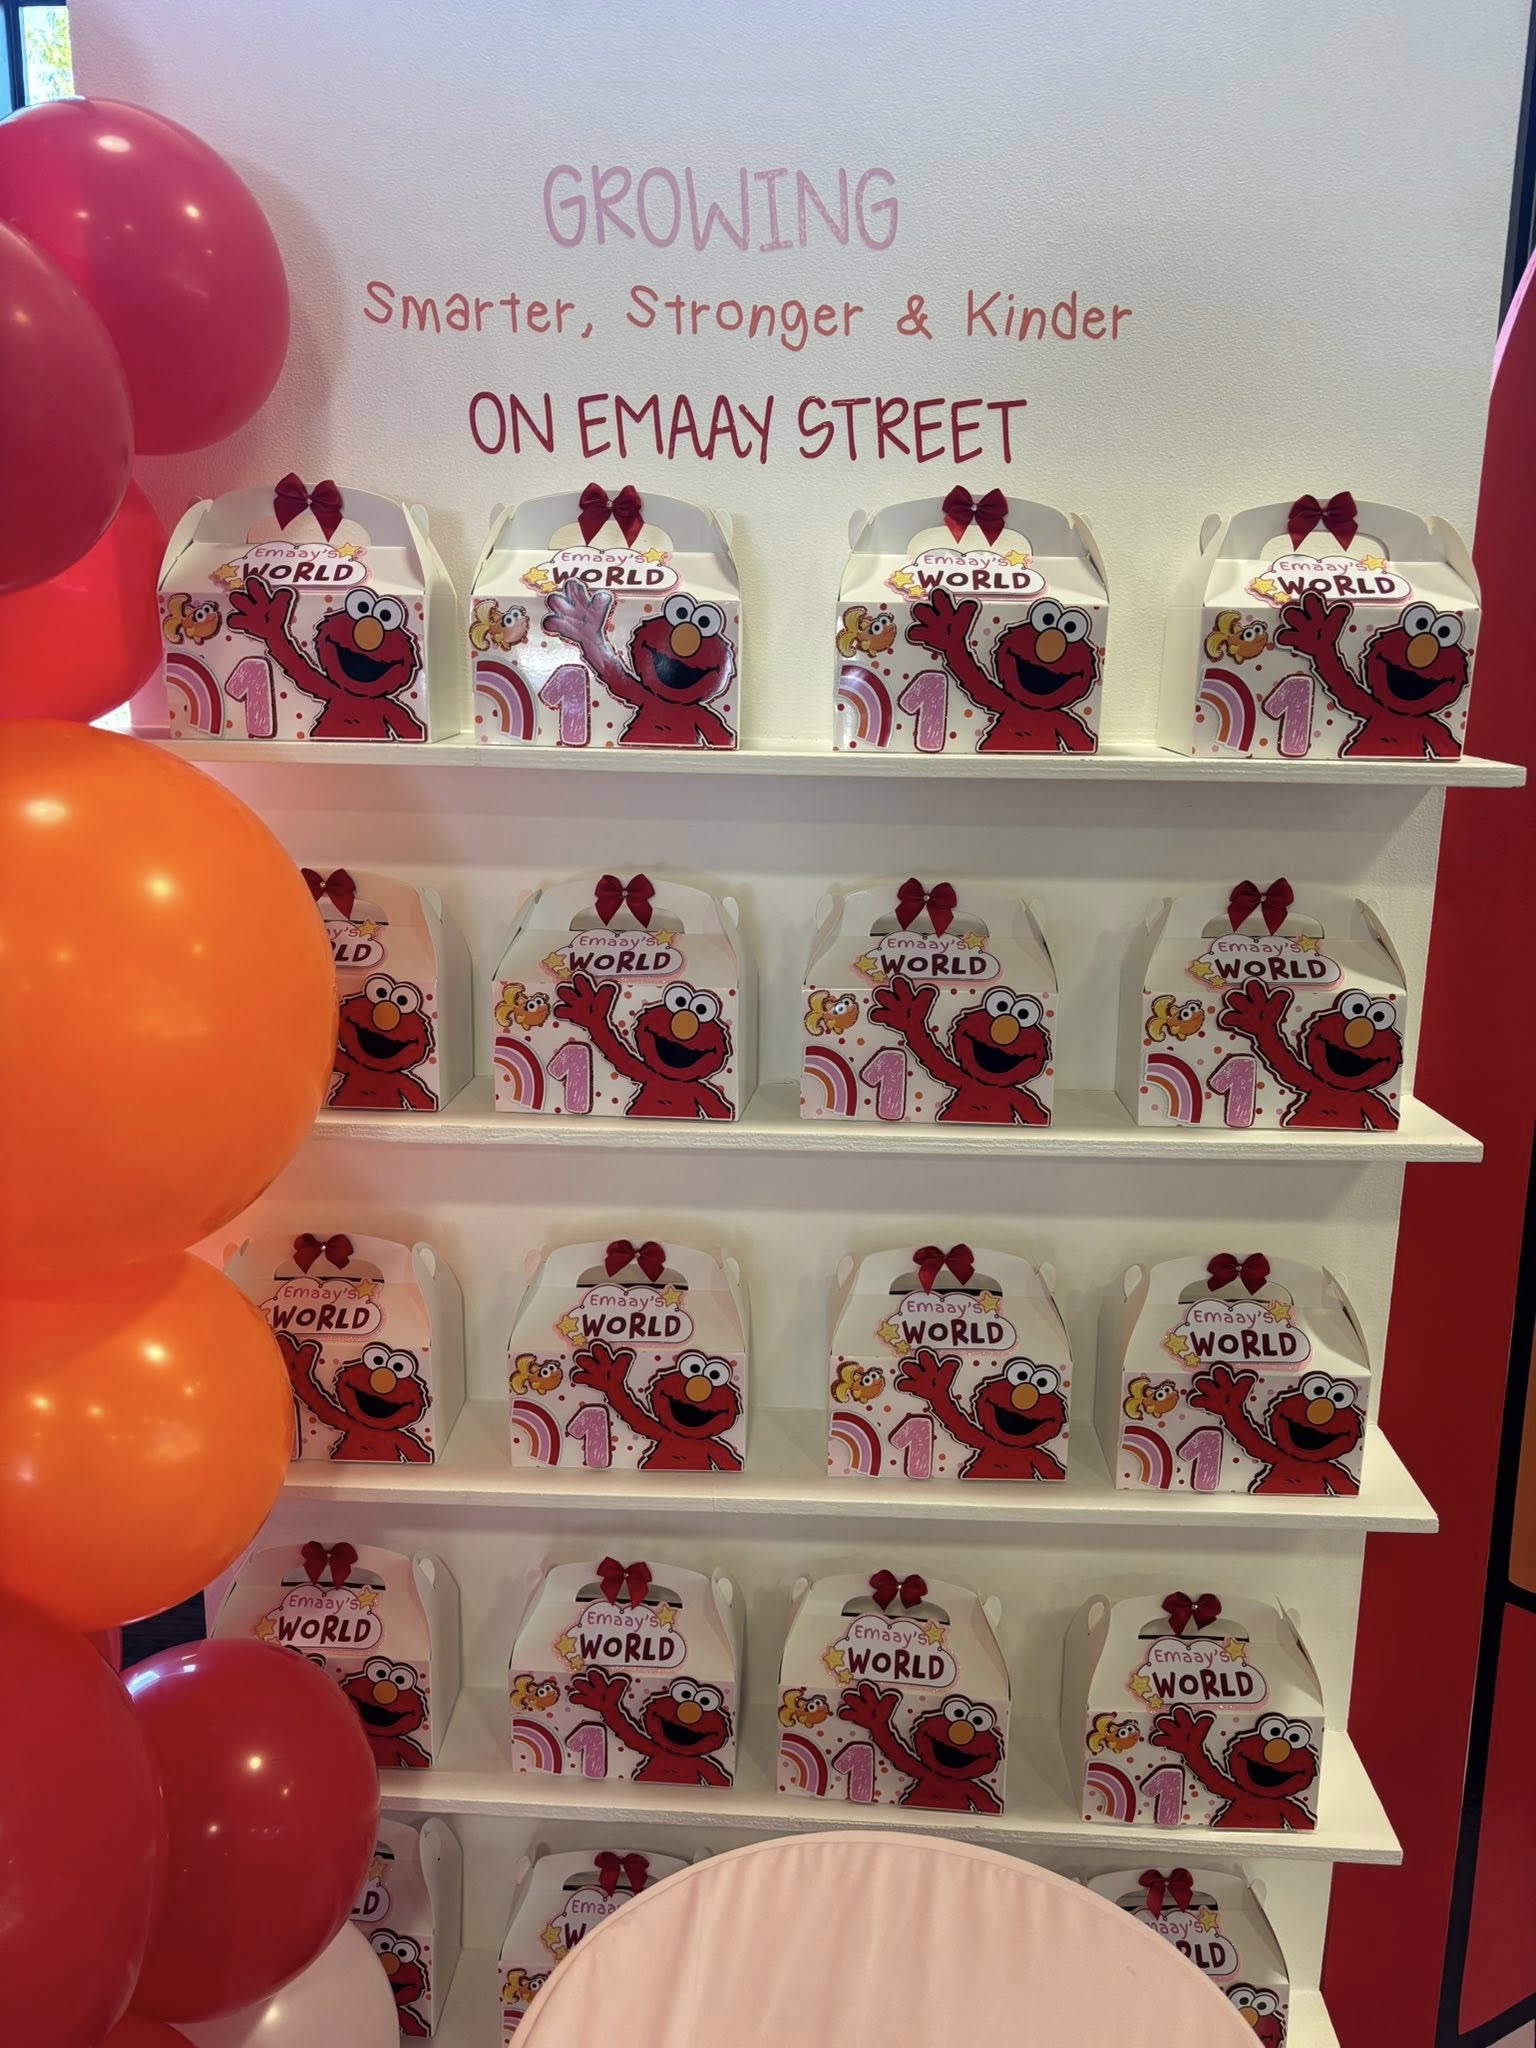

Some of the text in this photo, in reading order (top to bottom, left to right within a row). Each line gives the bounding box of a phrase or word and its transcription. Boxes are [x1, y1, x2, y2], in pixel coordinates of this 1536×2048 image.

[543, 164, 900, 252] GROWING
[363, 281, 1134, 351] Smarter, Stronger & Kinder
[469, 391, 1028, 465] ON EMAAY STREET
[254, 548, 338, 562] Emaay's
[561, 552, 646, 566] Emaay's
[924, 555, 1009, 569] Emaay's
[243, 562, 354, 583] WORLD
[552, 566, 665, 587] WORLD
[1279, 561, 1367, 575] Emaay's
[917, 569, 1031, 590] WORLD
[1277, 575, 1396, 596] WORLD
[579, 935, 657, 951] Emaay's
[887, 938, 967, 953] Emaay's
[1217, 942, 1302, 957] Emaay's
[570, 950, 671, 973] WORLD
[880, 953, 987, 976] WORLD
[1214, 957, 1327, 980] WORLD
[284, 1287, 358, 1304] Emaay's
[590, 1294, 664, 1311] Emaay's
[272, 1304, 370, 1331] WORLD
[907, 1300, 983, 1318] Emaay's
[1193, 1310, 1274, 1328] Emaay's
[582, 1312, 681, 1339] WORLD
[902, 1319, 1004, 1346] WORLD
[1190, 1329, 1297, 1359] WORLD
[289, 1594, 359, 1614] Emaay's
[278, 1615, 371, 1644] WORLD
[587, 1612, 659, 1632] Emaay's
[854, 1625, 928, 1648] Emaay's
[580, 1633, 675, 1663] WORLD
[1154, 1649, 1230, 1667] Emaay's
[847, 1647, 945, 1680] WORLD
[1152, 1668, 1254, 1700] WORLD
